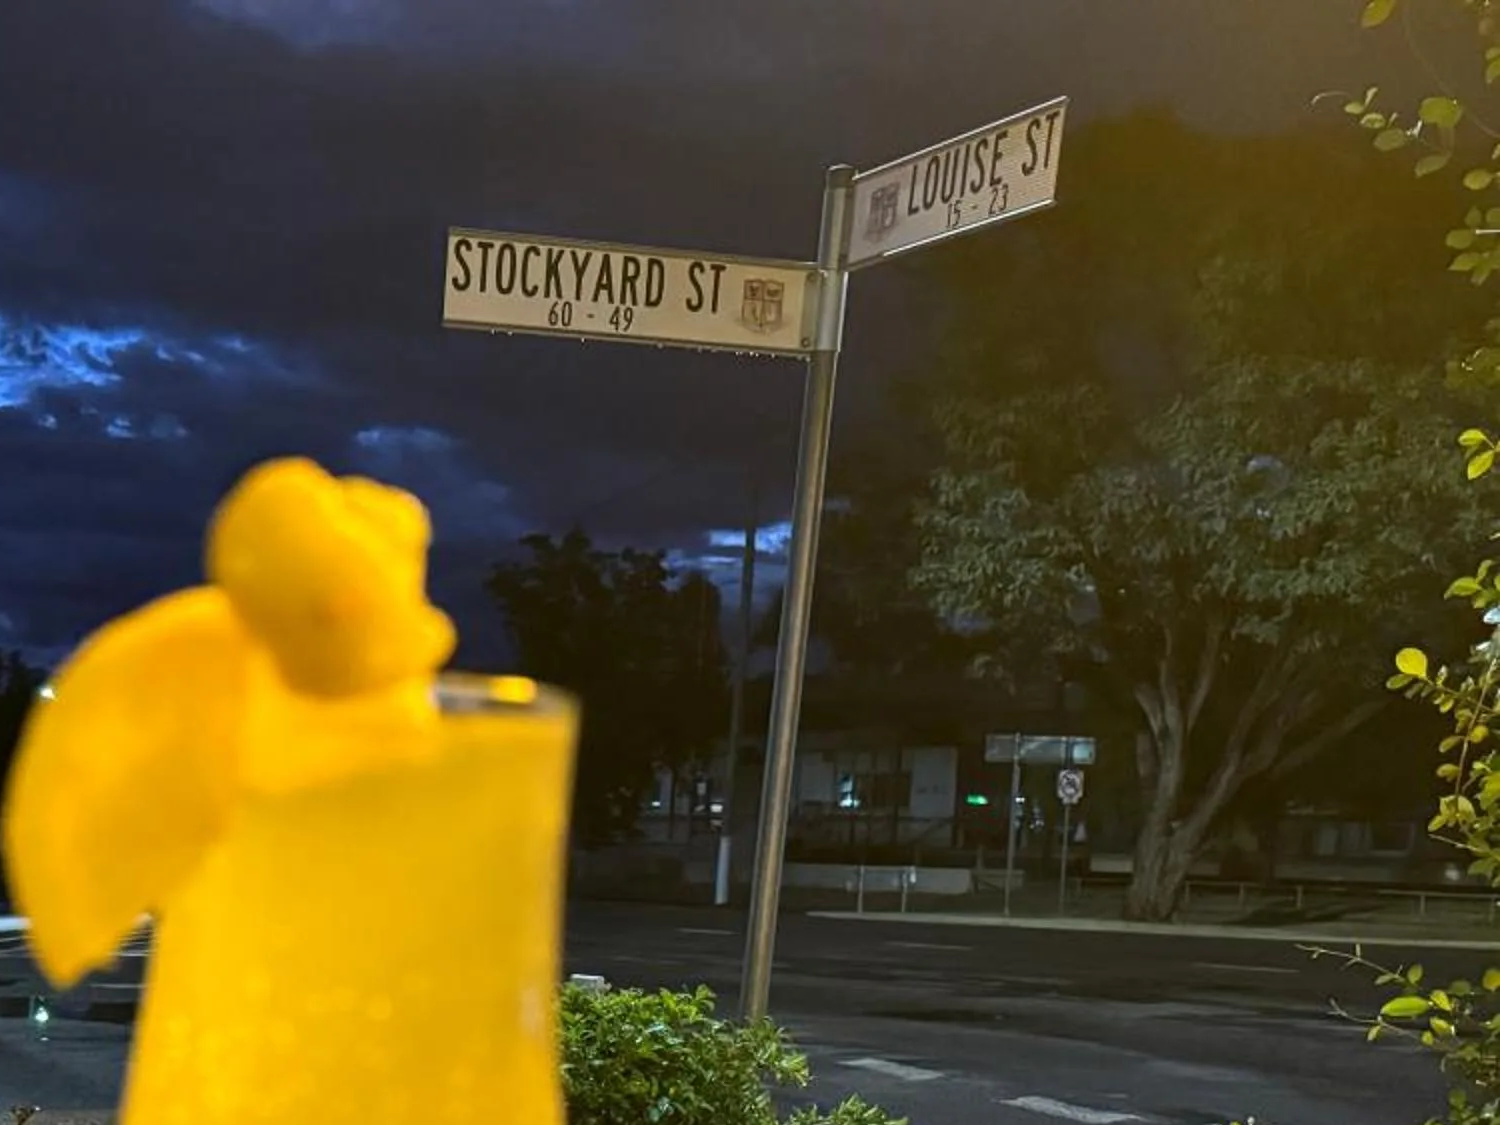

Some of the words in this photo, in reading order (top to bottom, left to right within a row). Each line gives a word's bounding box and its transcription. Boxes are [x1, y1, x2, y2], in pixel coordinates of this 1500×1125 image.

[908, 131, 1008, 216] LOUISE
[1022, 112, 1060, 177] ST
[946, 202, 961, 230] 15
[987, 183, 1009, 217] 23
[451, 238, 666, 308] STOCKYARD
[686, 260, 727, 315] ST
[548, 301, 573, 328] 60
[609, 306, 634, 333] 49
